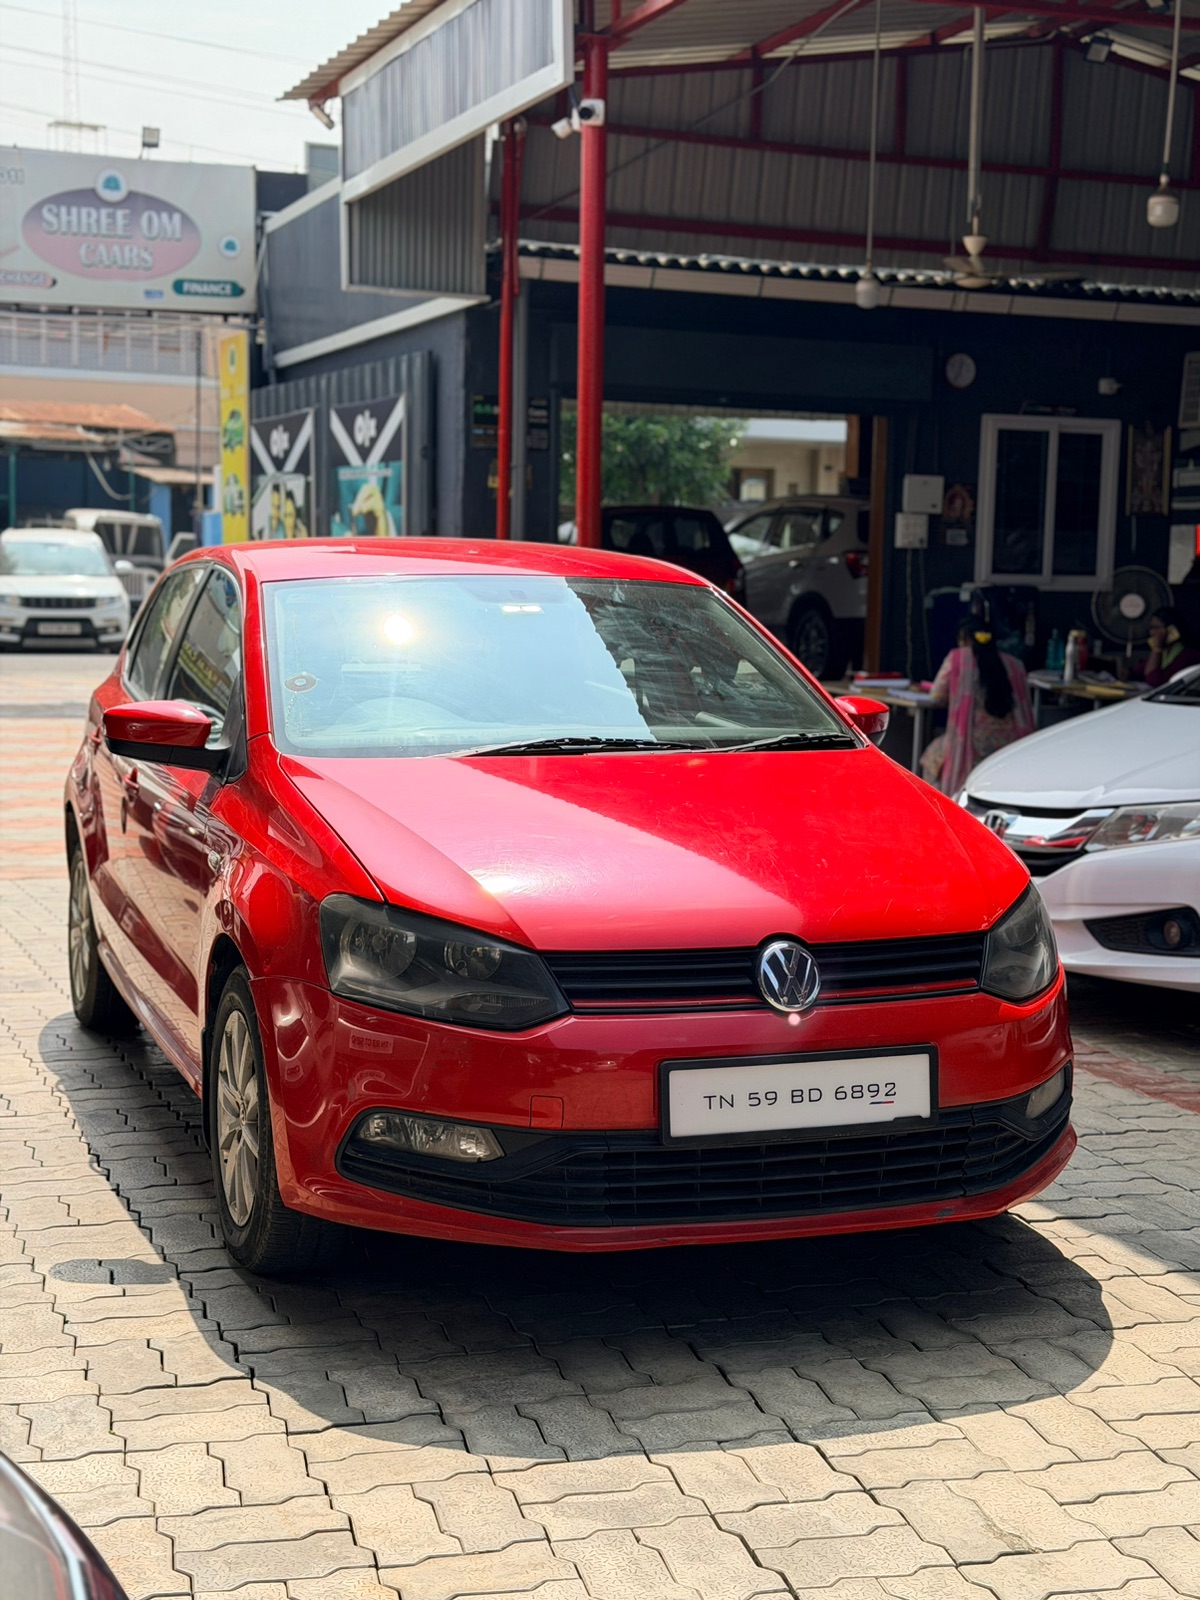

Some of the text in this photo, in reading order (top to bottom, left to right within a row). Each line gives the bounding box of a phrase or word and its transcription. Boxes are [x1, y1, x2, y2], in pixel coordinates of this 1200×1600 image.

[41, 204, 182, 242] SHREE OM
[79, 243, 154, 271] CAARS
[182, 281, 233, 296] FINANCE
[703, 1082, 897, 1110] TN 59 BD 6892
